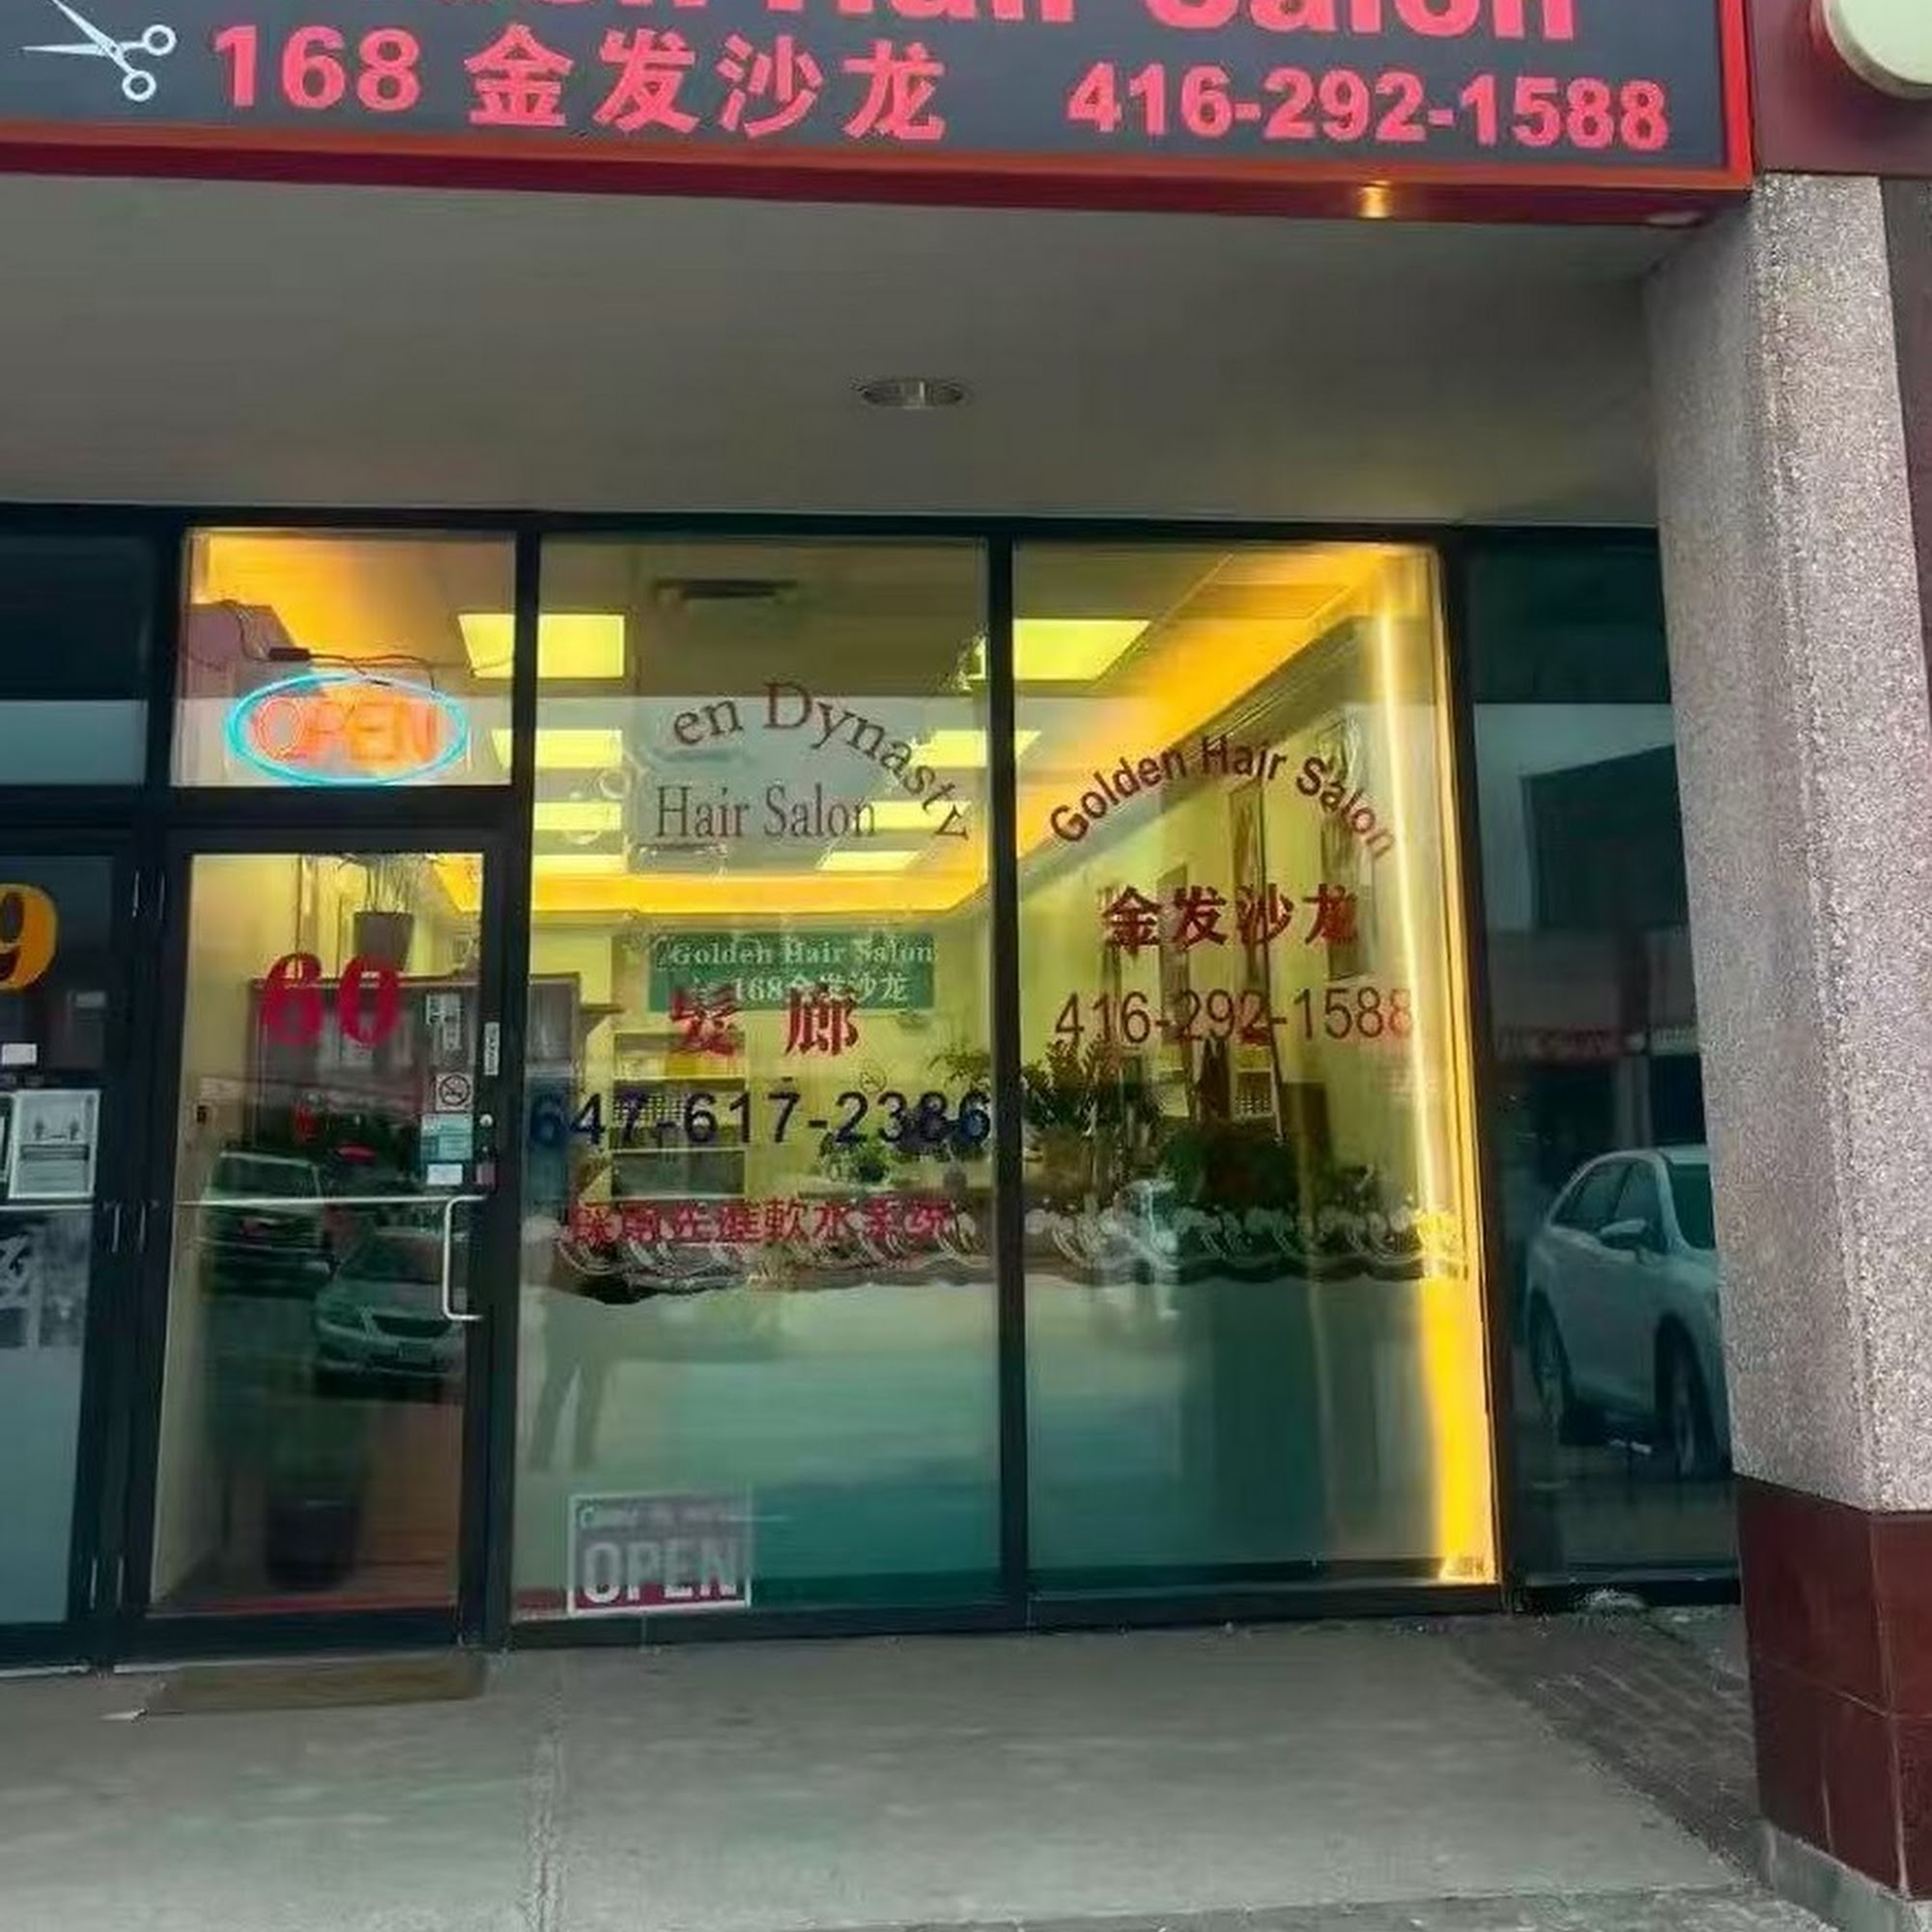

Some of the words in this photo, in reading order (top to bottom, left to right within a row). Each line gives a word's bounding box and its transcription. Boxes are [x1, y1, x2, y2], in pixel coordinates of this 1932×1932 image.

[213, 25, 421, 112] 168
[462, 24, 948, 141] 金发沙龙
[1067, 62, 1669, 151] 416-292-1588
[251, 695, 444, 765] OPEN
[655, 783, 751, 838] Hair
[762, 777, 876, 838] Salon
[1049, 748, 1188, 843] Golden
[1201, 734, 1288, 781] Hair
[1294, 755, 1394, 858] Salon
[1102, 883, 1358, 952] 金发沙龙
[262, 952, 399, 1047] 60
[1054, 986, 1414, 1045] 416-292-1588
[528, 1090, 992, 1147] 647-617-2386
[582, 1539, 739, 1605] OPEN
